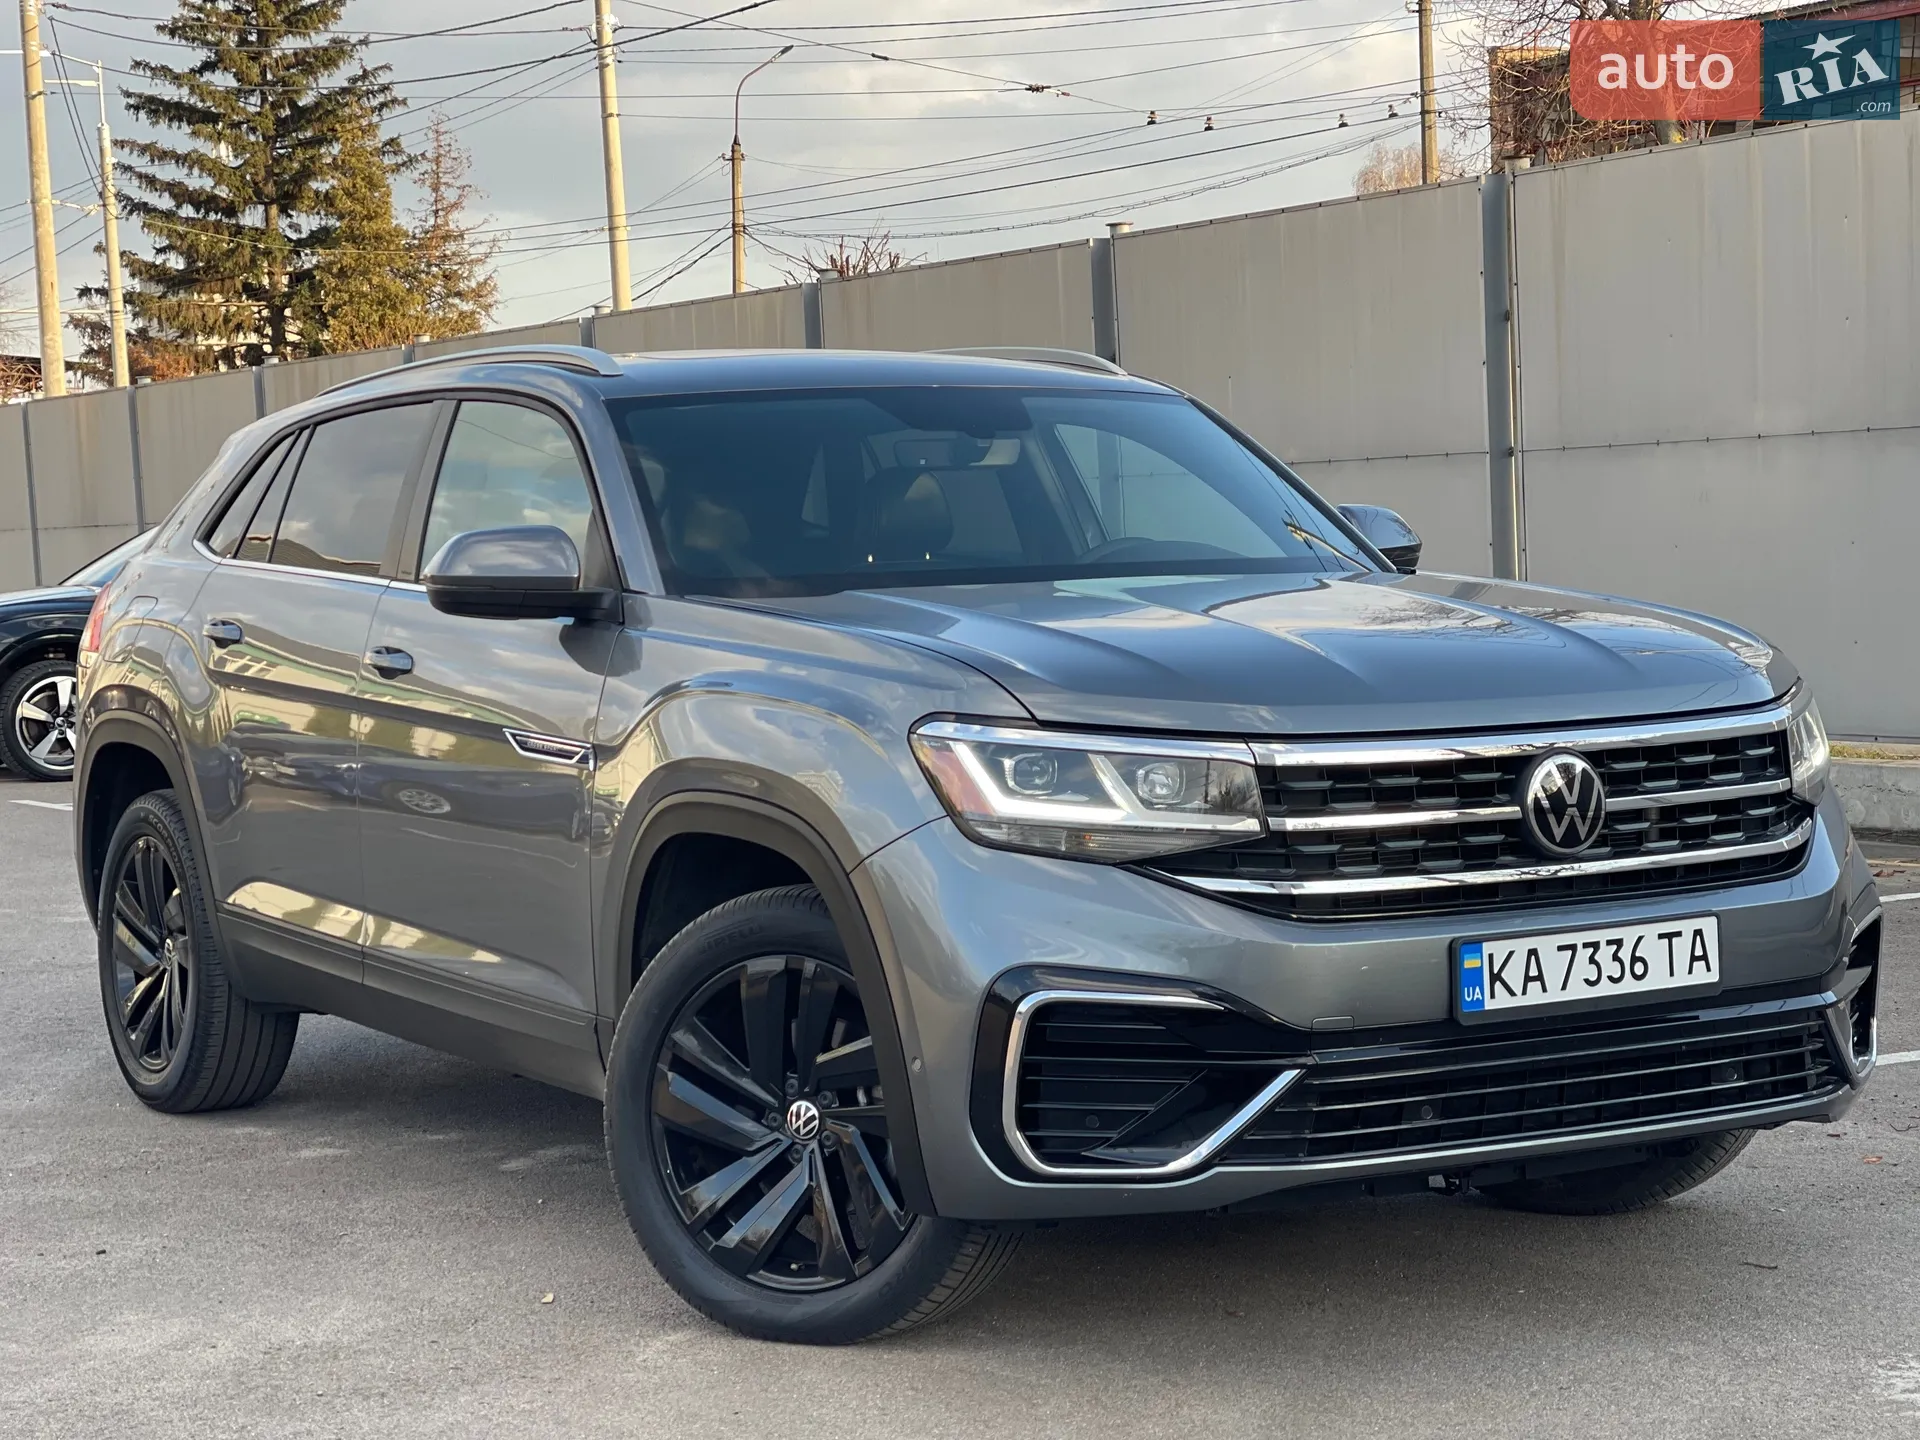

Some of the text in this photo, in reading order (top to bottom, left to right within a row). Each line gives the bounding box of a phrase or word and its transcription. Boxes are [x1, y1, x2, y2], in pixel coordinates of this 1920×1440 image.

[1487, 927, 1712, 1000] KA 7336 TA
[1464, 986, 1483, 1002] UA
